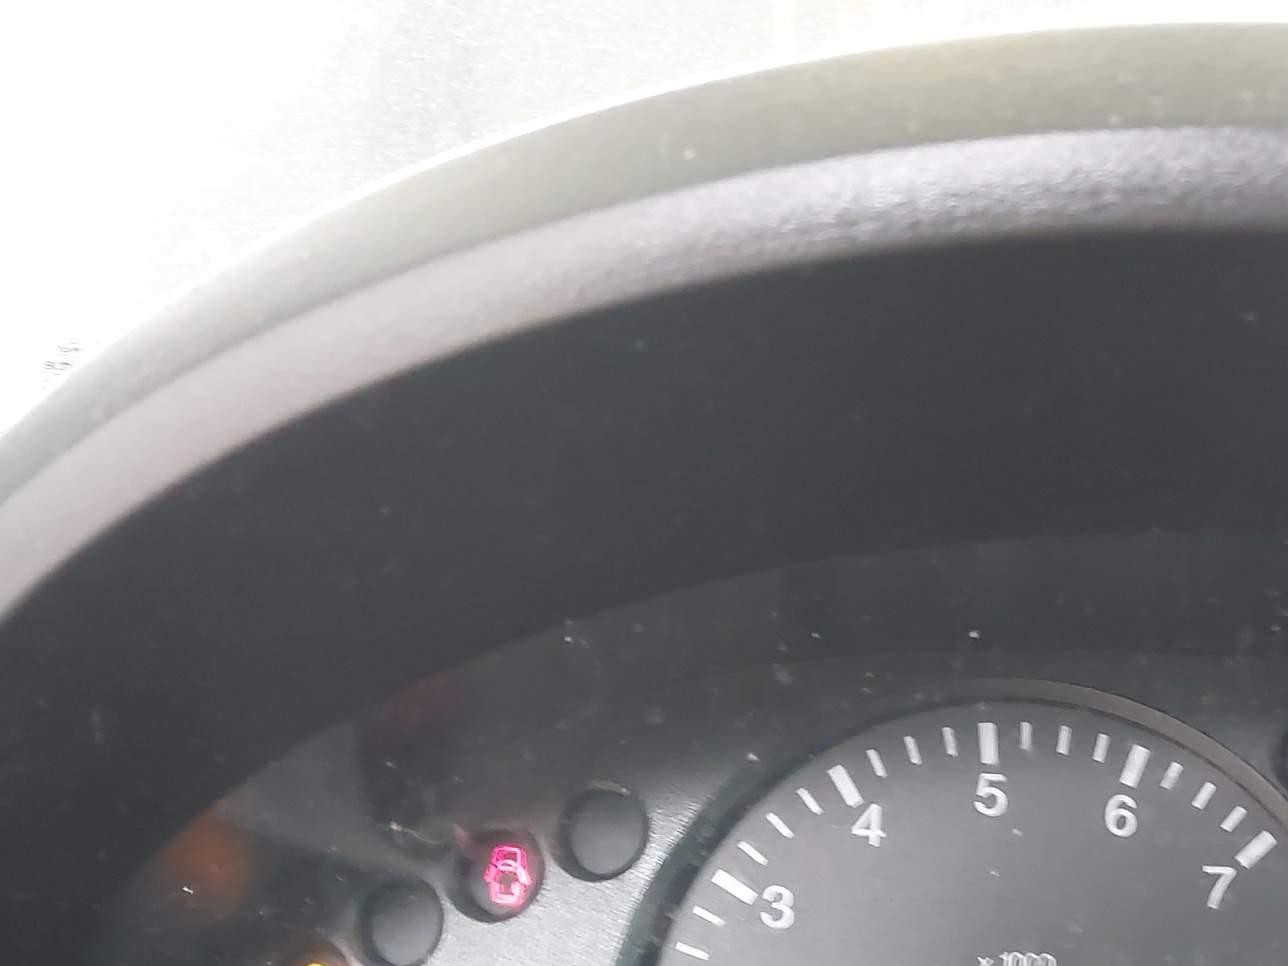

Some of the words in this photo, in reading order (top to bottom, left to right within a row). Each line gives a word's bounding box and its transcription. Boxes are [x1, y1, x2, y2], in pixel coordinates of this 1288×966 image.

[973, 774, 1009, 817] 5
[1104, 795, 1139, 837] 6
[852, 803, 885, 847] 4
[760, 884, 795, 929] 3
[1202, 865, 1238, 909] 7
